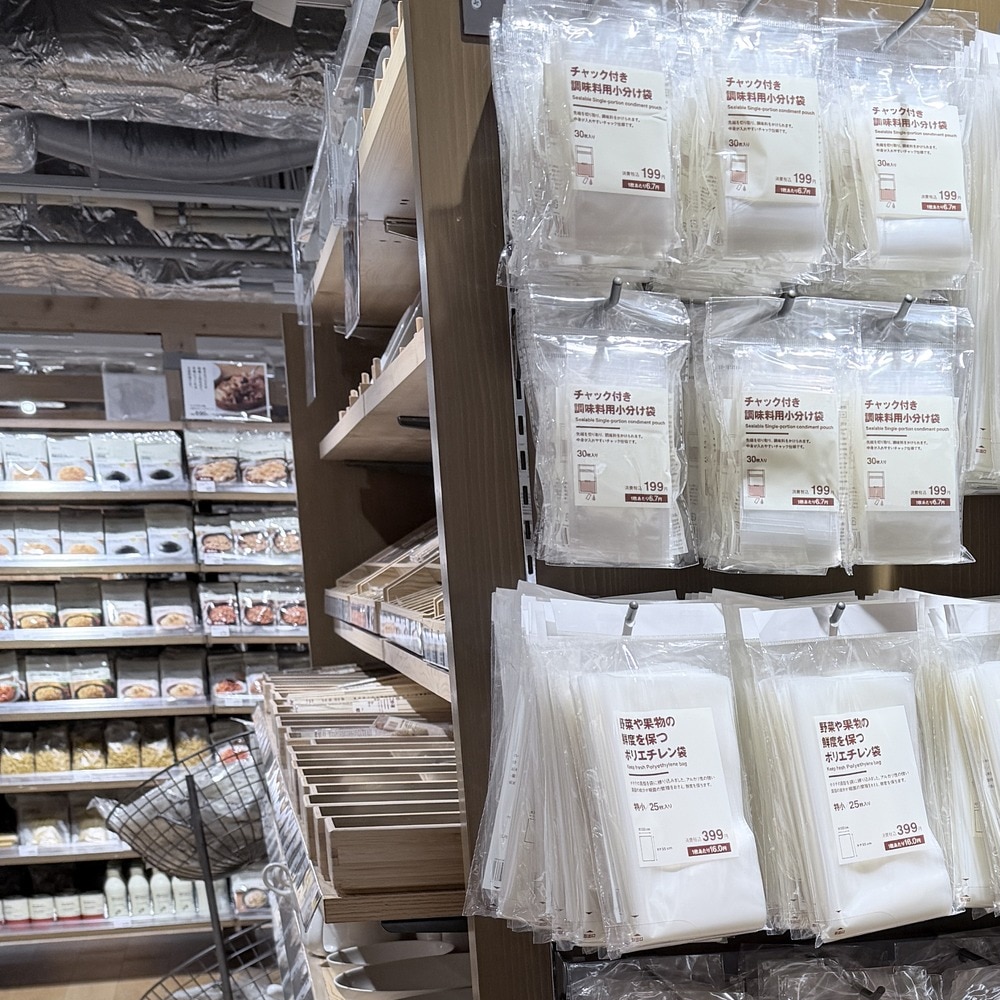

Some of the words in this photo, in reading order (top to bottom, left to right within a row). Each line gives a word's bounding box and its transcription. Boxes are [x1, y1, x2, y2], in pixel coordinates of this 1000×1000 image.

[571, 66, 628, 83] チャック付き
[726, 77, 781, 90] チャック付き
[571, 81, 652, 100] 調味料用小分け袋
[726, 91, 805, 106] 調味料用小分け袋
[873, 107, 923, 118] チャック付き
[873, 118, 947, 130] 調味料用小分け袋
[574, 390, 631, 402] チャック付き
[745, 397, 800, 407] チャック付き
[574, 404, 655, 416] 調味料用小分け袋
[865, 400, 917, 410] チャック付き
[745, 410, 824, 421] 調味料用小分け袋
[865, 413, 940, 423] 調味料用小分け袋
[819, 718, 869, 733] 野菜や果物の
[822, 733, 864, 748] 鮮度を保つ
[825, 746, 881, 763] ポリエチレン袋
